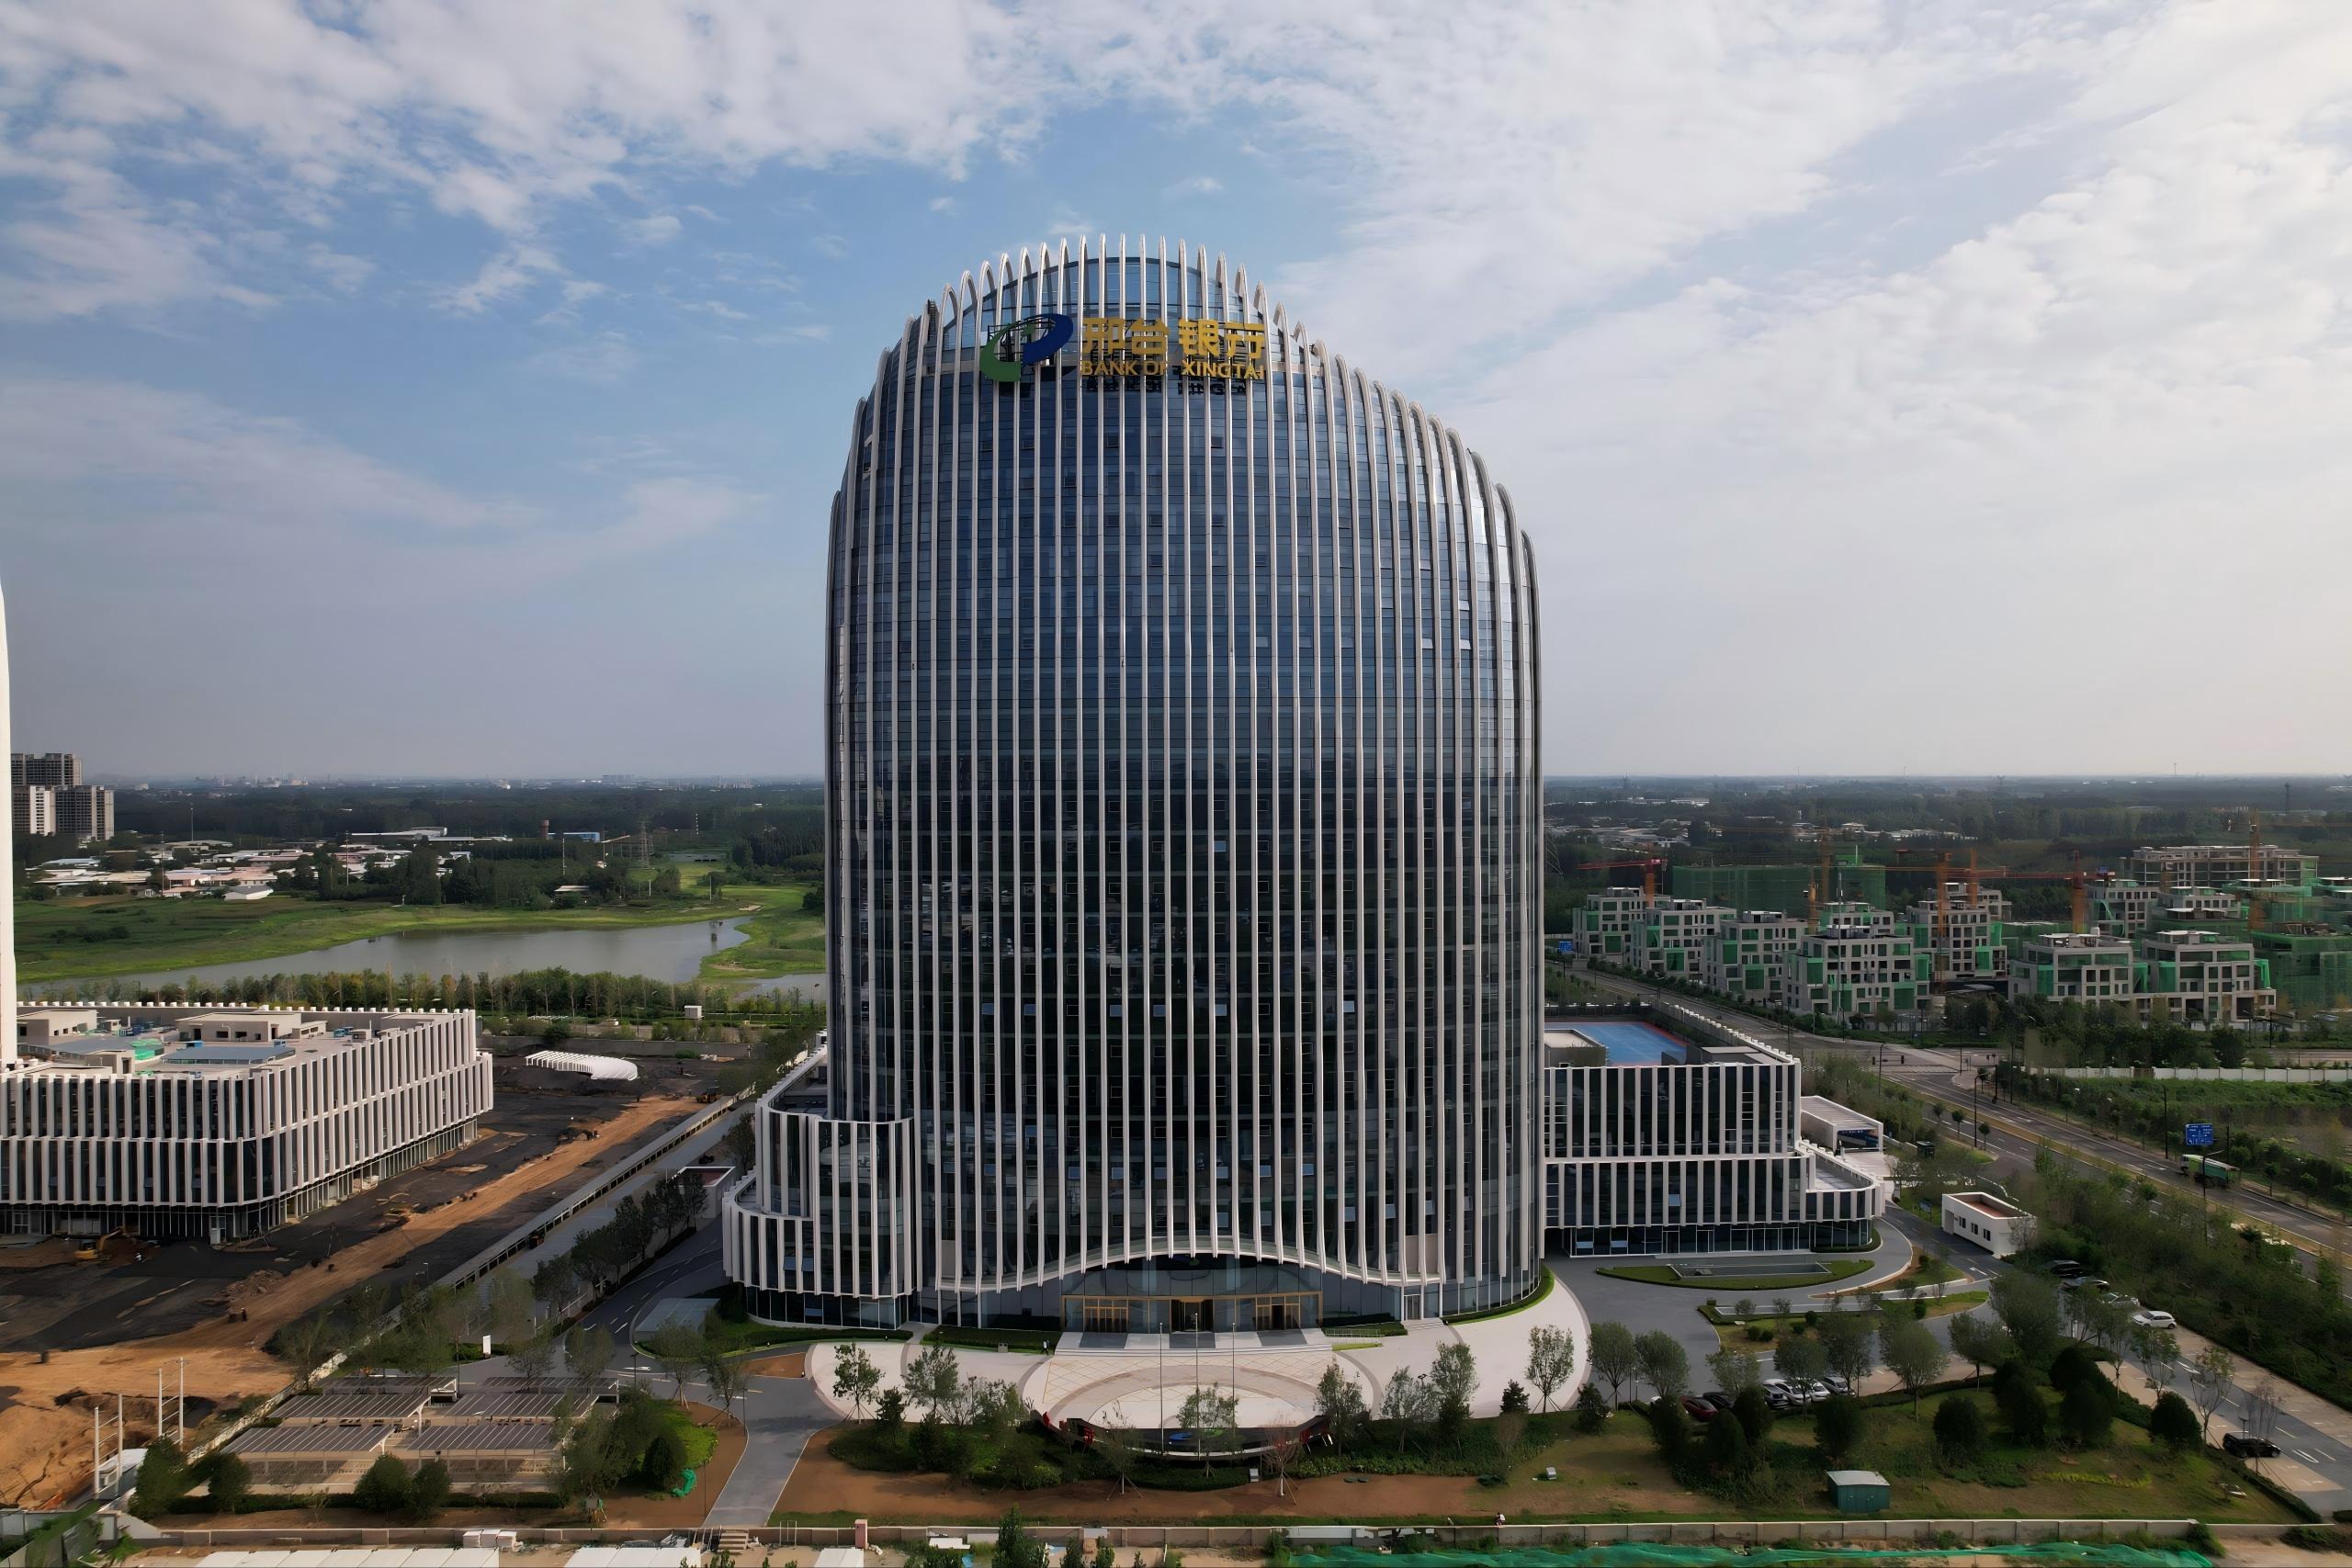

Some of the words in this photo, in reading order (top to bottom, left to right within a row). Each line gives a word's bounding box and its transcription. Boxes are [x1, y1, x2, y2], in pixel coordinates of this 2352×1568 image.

[1082, 317, 1265, 359] 邢台银行
[1081, 360, 1140, 376] BANK
[1143, 360, 1167, 376] OF
[1182, 359, 1265, 379] XINGTAI
